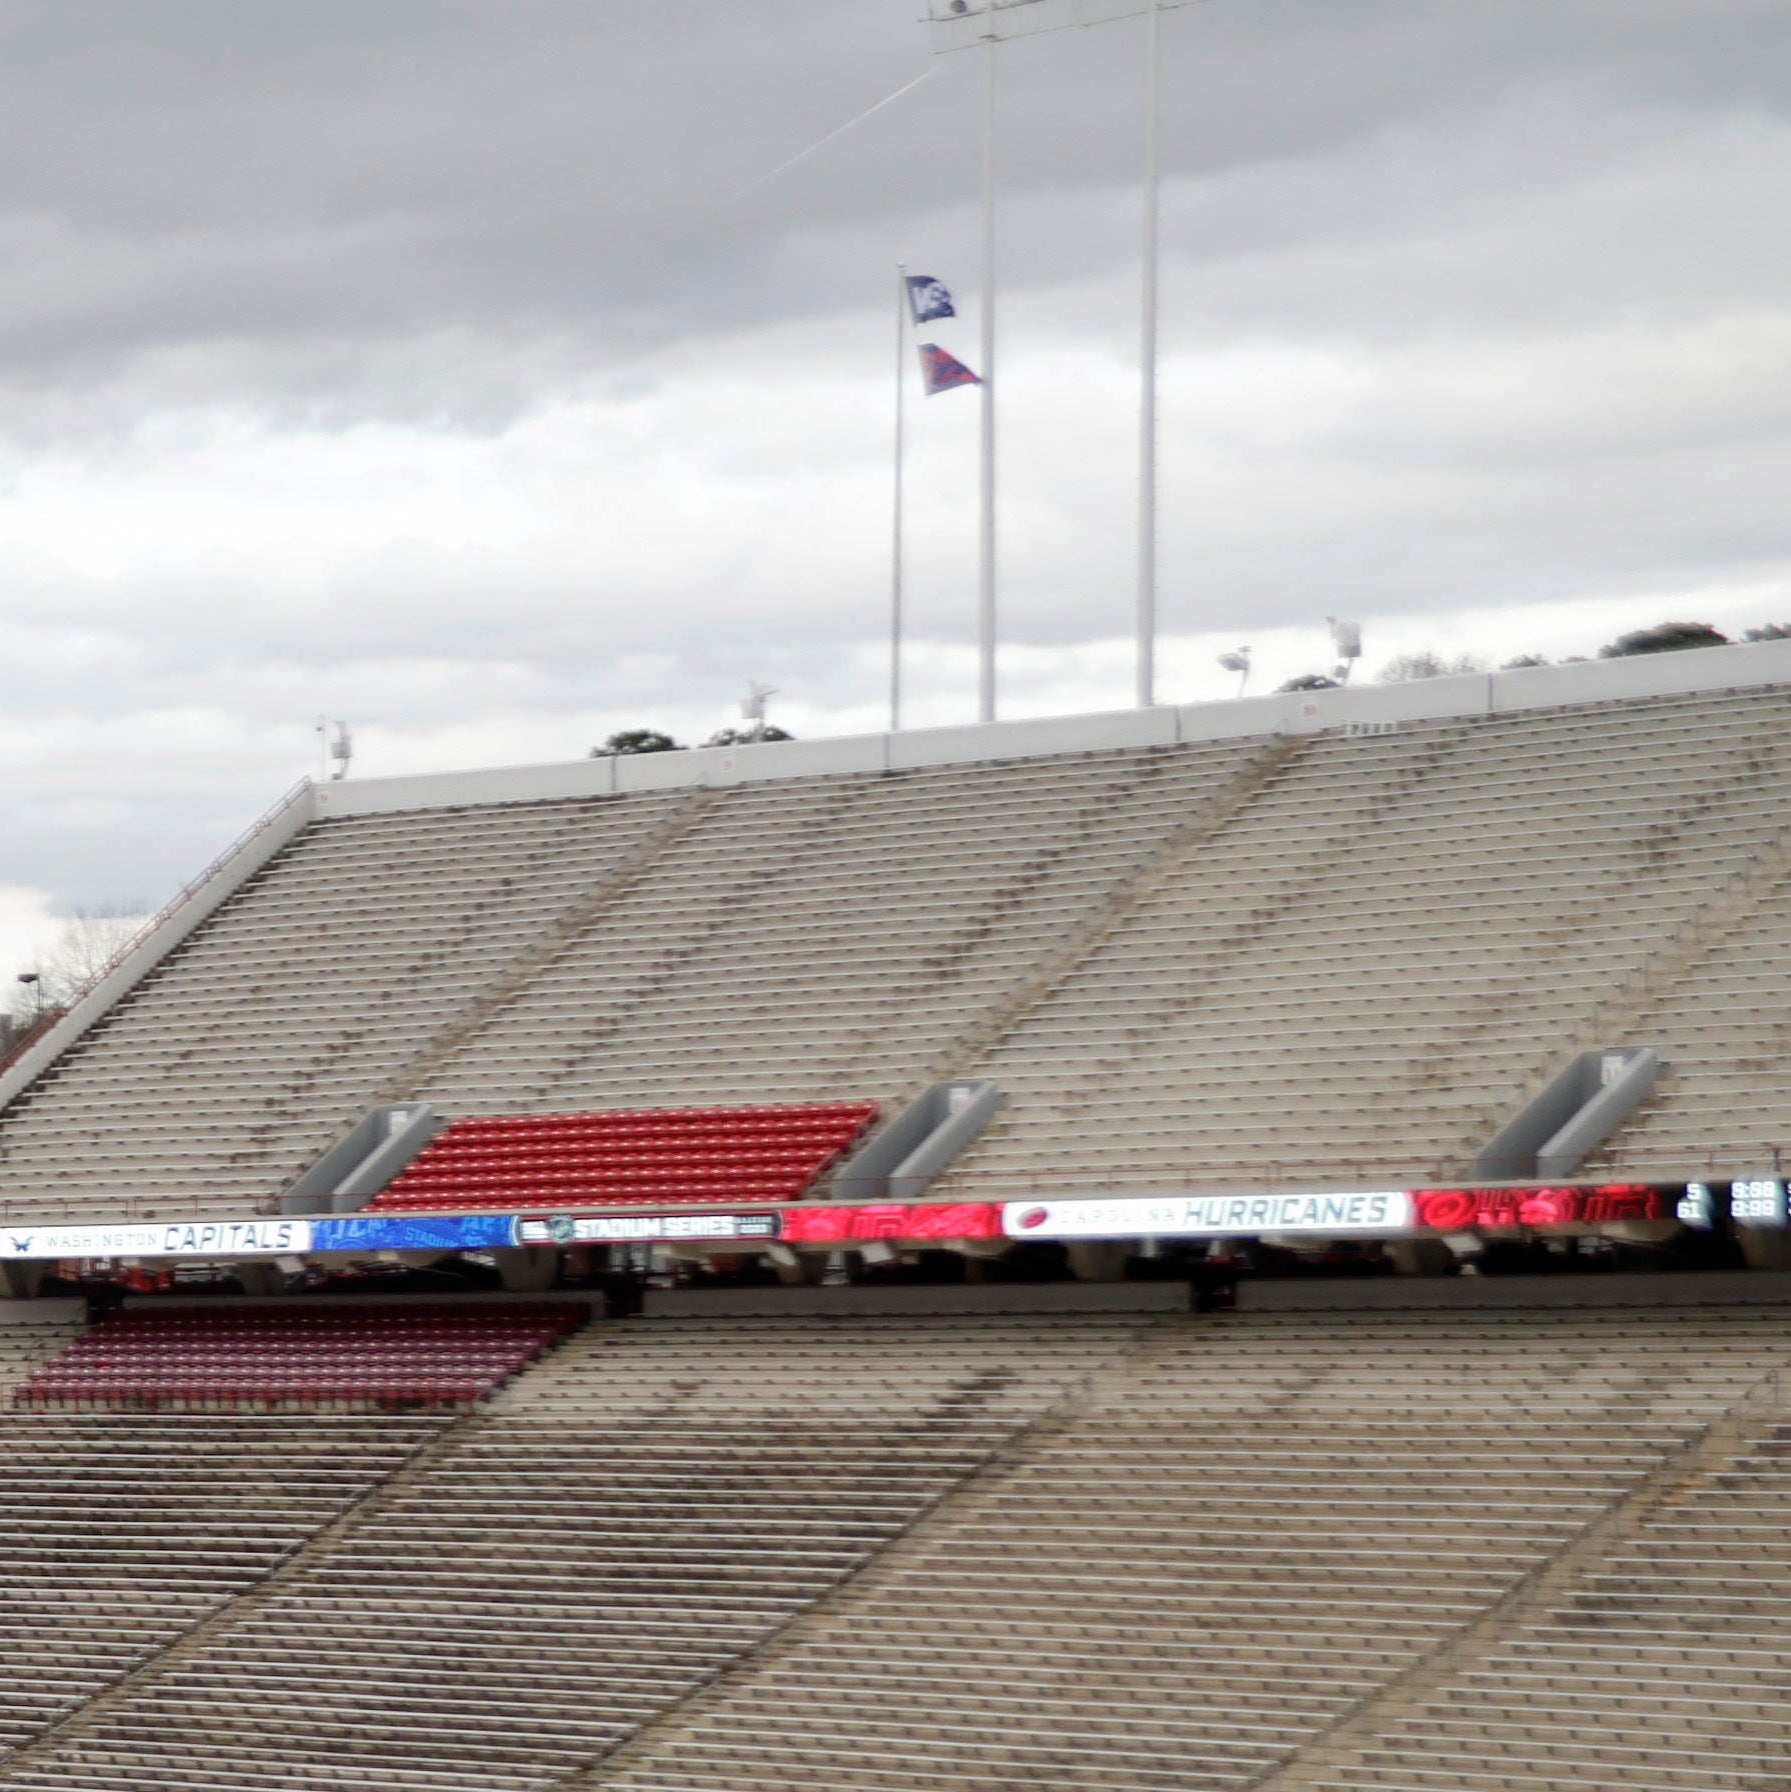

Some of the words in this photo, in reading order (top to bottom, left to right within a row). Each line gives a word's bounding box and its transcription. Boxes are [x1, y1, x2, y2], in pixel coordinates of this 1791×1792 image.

[1182, 1196, 1387, 1227] HURRICANES
[163, 1223, 292, 1251] CAPITALS
[574, 1217, 661, 1238] STADIUM
[663, 1215, 734, 1236] SERIES
